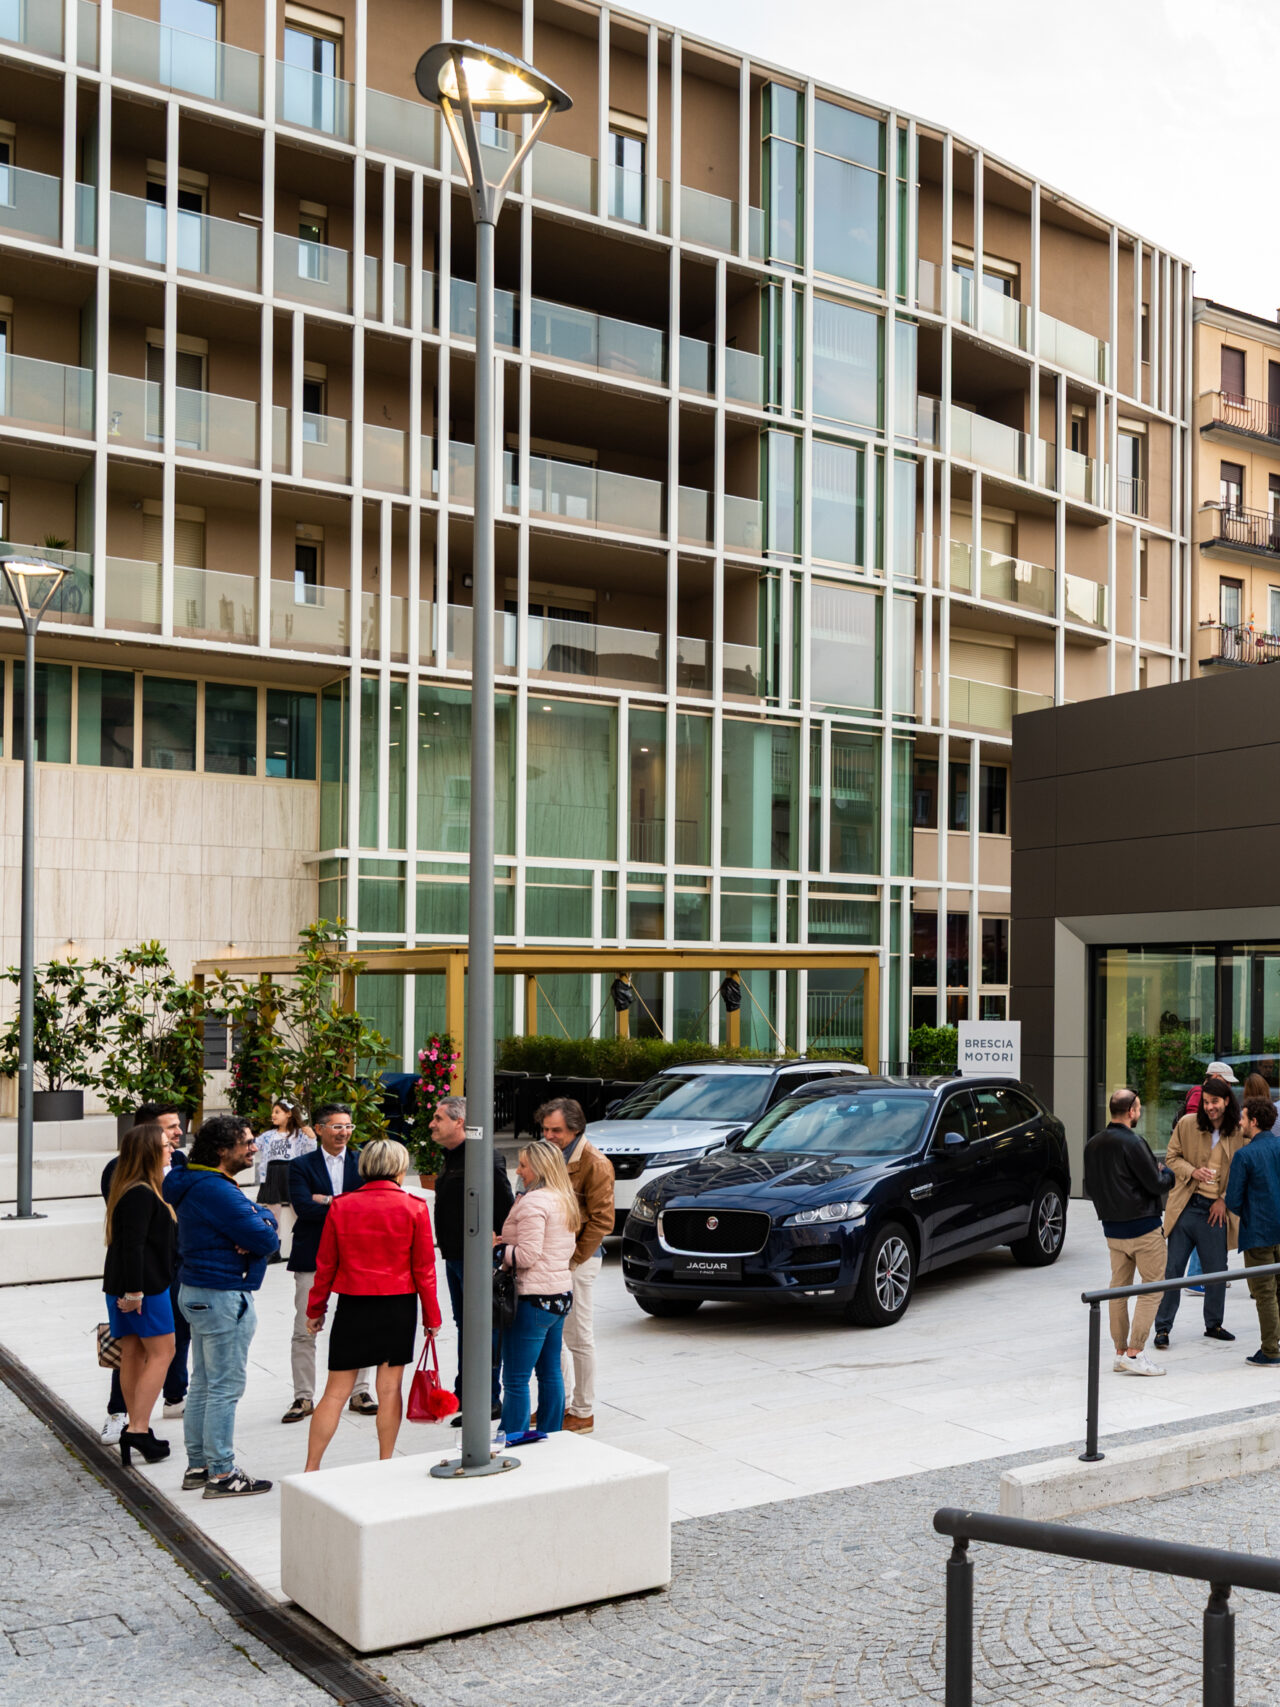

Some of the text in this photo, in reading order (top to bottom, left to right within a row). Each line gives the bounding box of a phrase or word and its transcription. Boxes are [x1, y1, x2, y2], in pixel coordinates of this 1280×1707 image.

[965, 1039, 1014, 1049] BRESCIA
[965, 1052, 1014, 1062] MOTORI
[686, 1262, 728, 1270] JAGUAR
